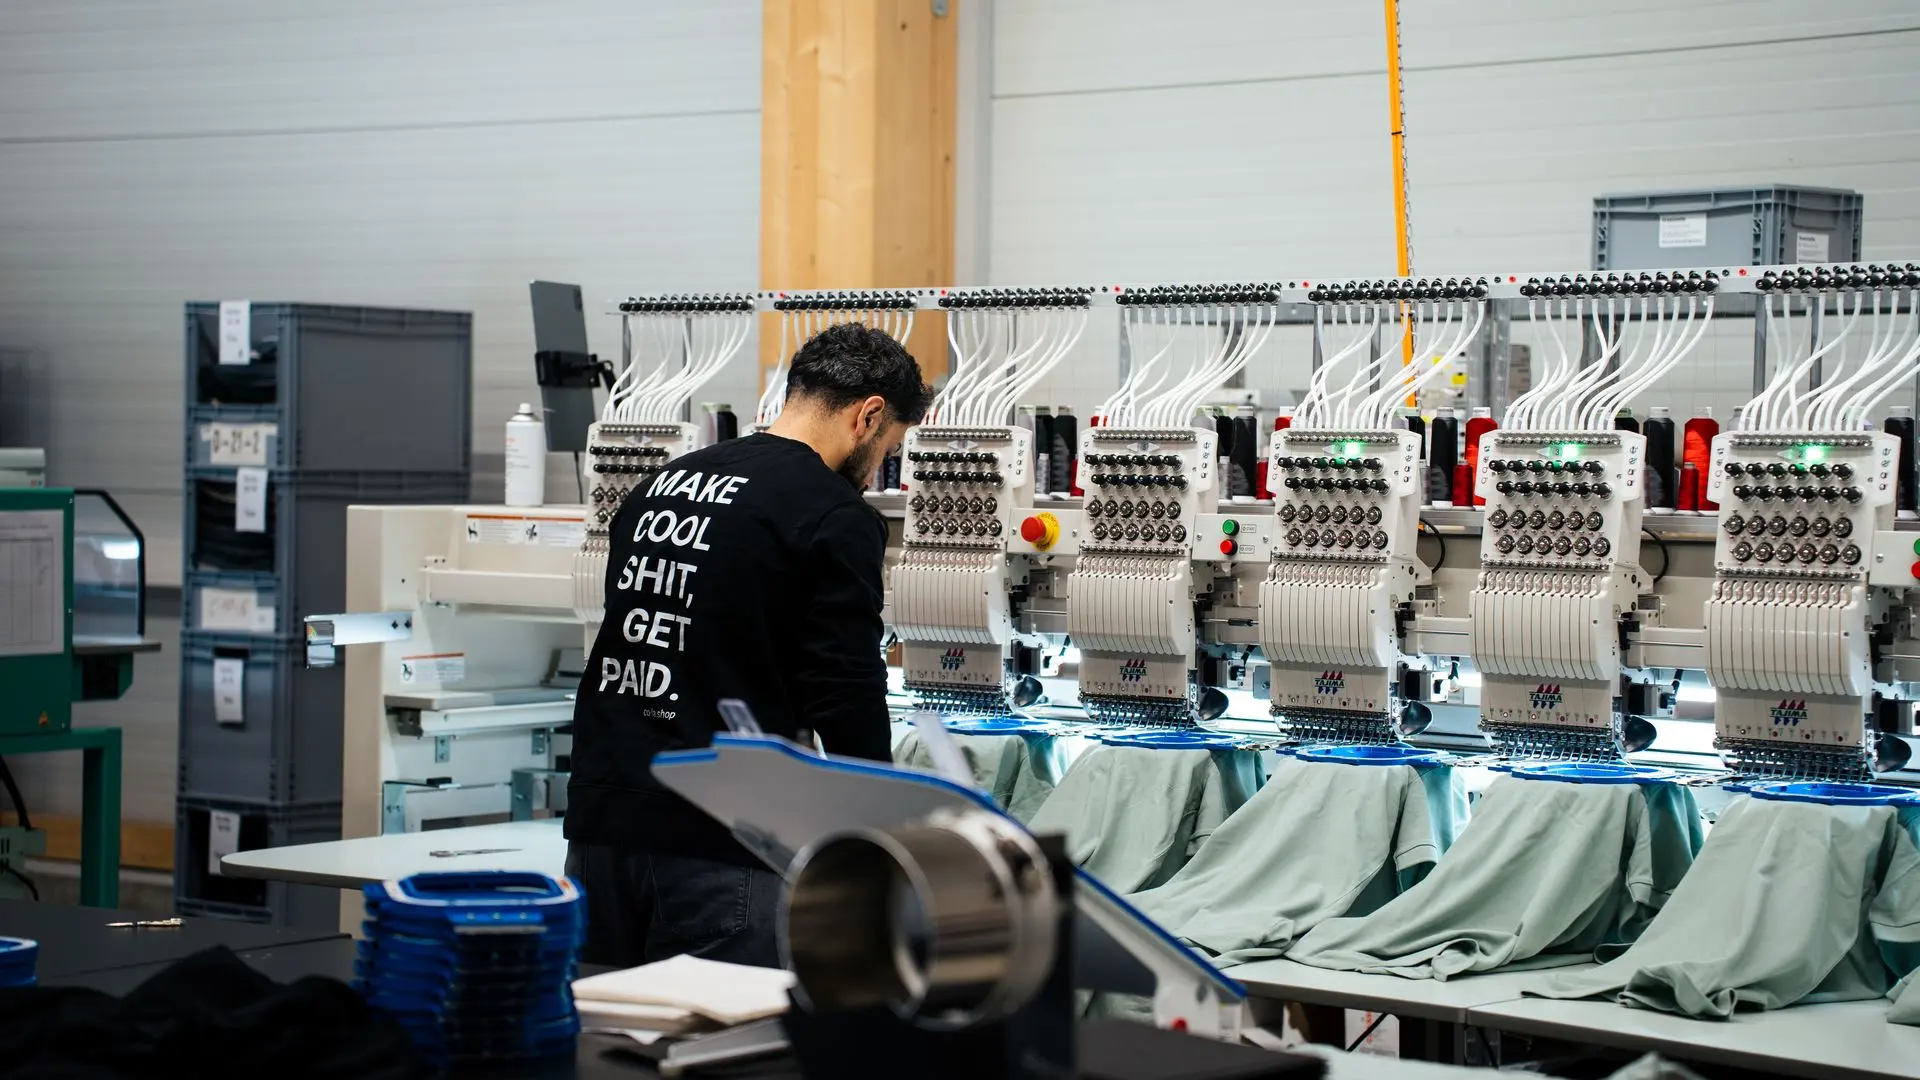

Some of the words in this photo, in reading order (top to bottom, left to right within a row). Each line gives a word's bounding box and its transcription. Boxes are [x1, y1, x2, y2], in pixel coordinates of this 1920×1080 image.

[646, 469, 749, 505] MAKE
[633, 510, 711, 551] COOL
[617, 555, 697, 608] SHIT,
[623, 607, 691, 651] GET
[599, 657, 678, 701] PAID.
[1120, 667, 1146, 676] TAJIMA
[1315, 679, 1344, 687] TAJIMA
[1530, 693, 1562, 703] TAJIMA
[1770, 709, 1807, 718] TAJIMA
